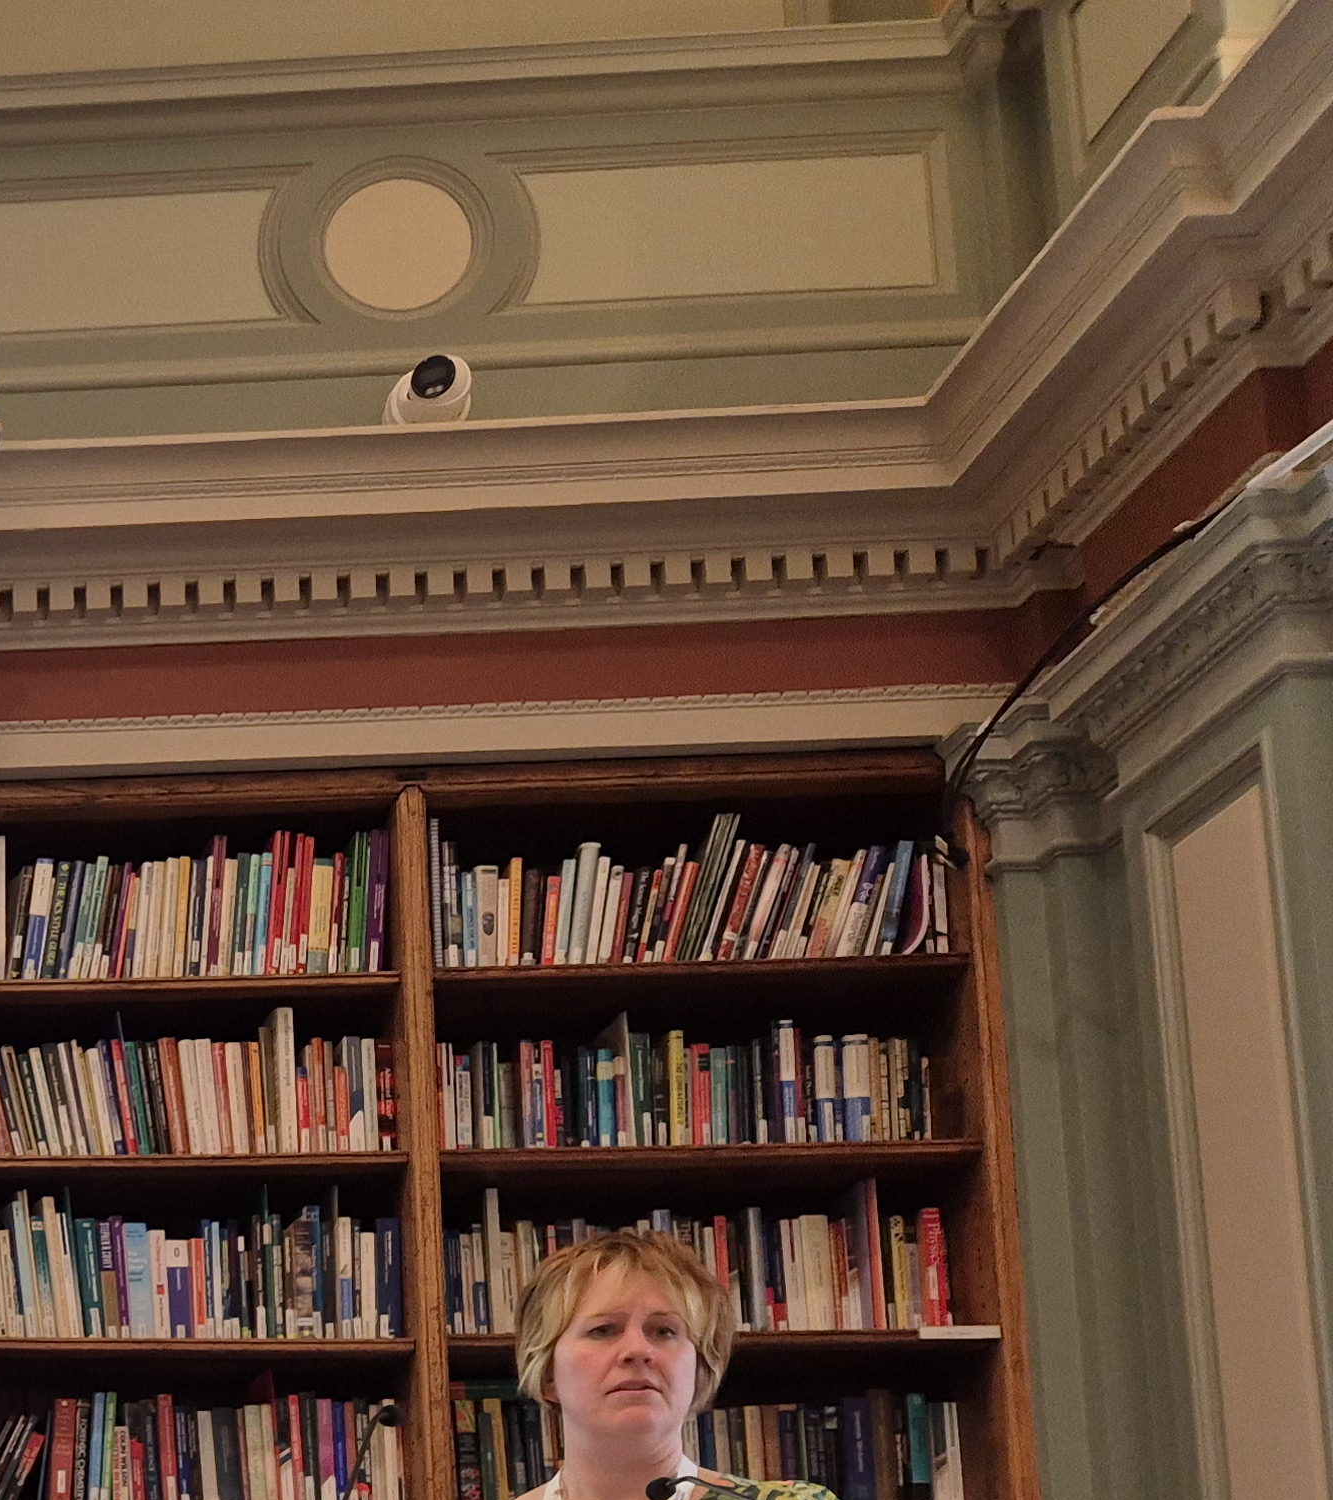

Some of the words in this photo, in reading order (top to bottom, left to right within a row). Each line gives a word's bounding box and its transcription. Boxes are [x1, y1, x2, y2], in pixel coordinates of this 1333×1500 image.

[49, 916, 61, 940] STYLE
[46, 941, 58, 966] GUIDE
[78, 1418, 88, 1458] FORENSIC
